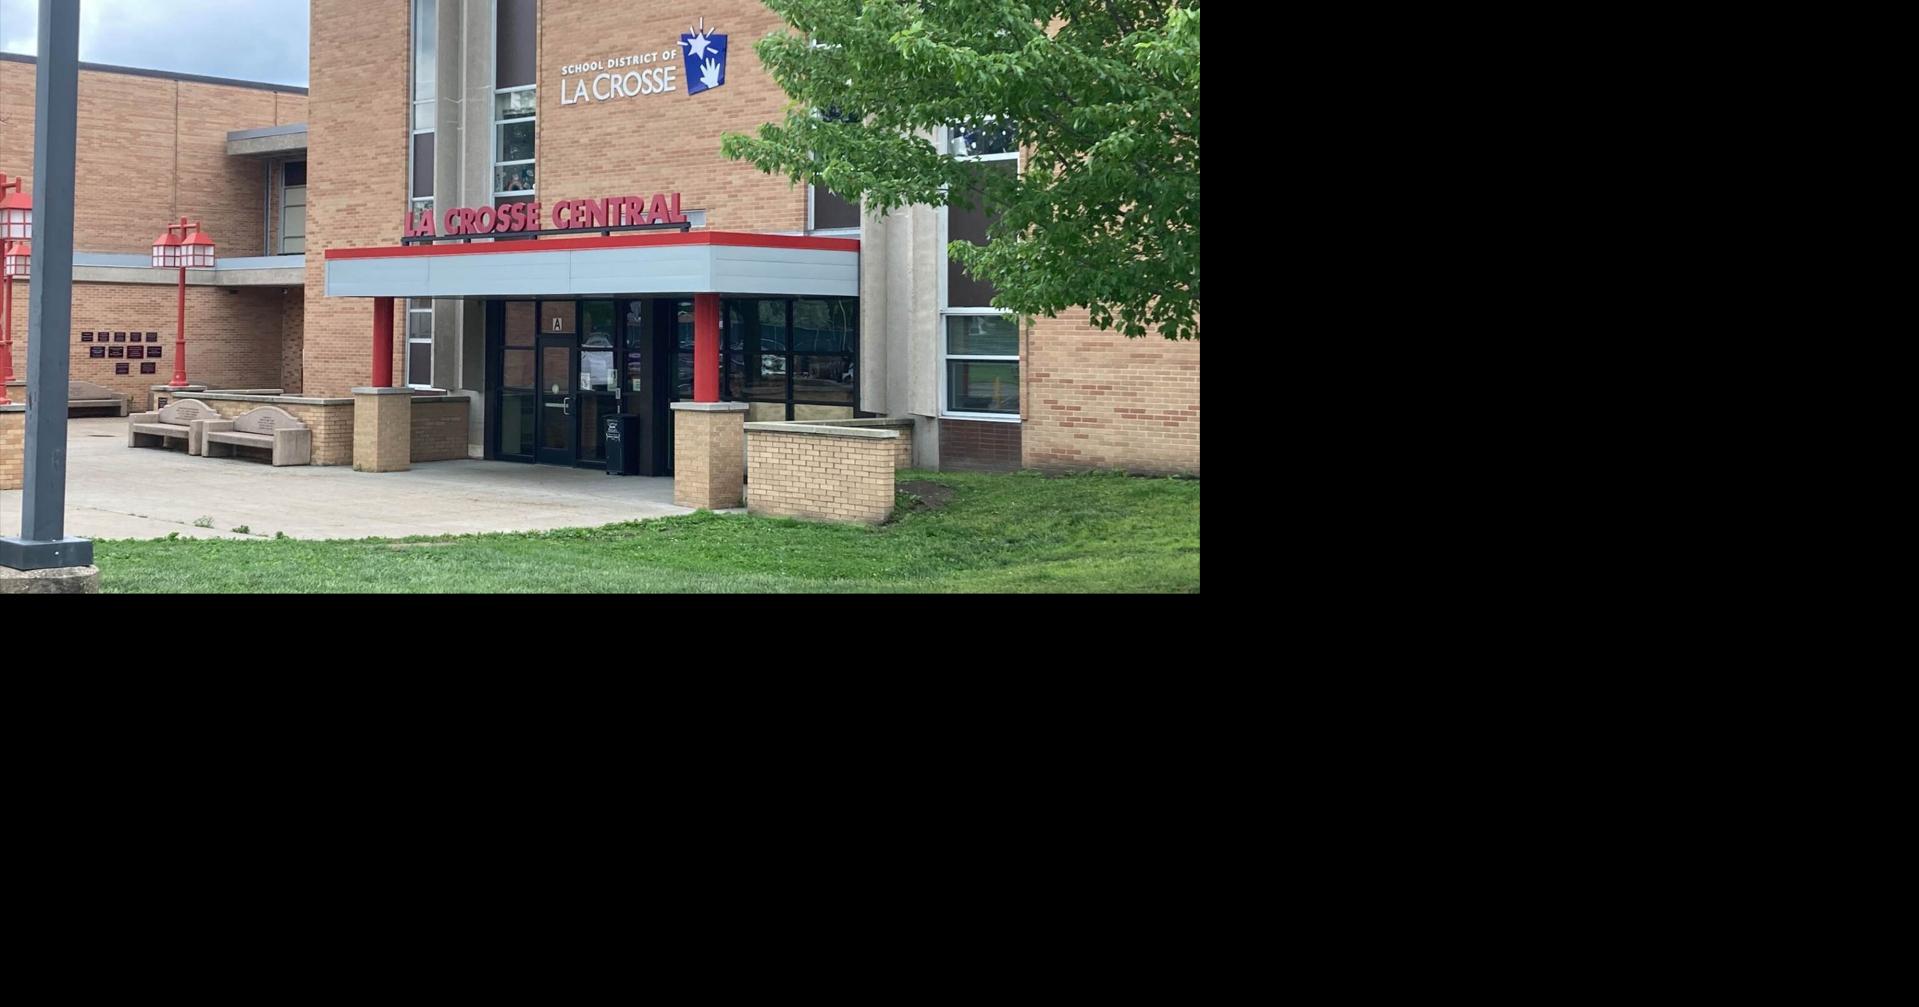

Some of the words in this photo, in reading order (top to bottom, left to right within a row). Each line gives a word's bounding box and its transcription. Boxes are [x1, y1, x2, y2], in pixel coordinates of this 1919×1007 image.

[561, 61, 604, 75] SCHOOL
[607, 52, 658, 68] DISTRICT
[662, 49, 677, 61] OF
[561, 78, 590, 105] LA
[592, 65, 677, 101] CROSSE
[404, 208, 436, 237] LA
[444, 202, 542, 235] CROSSE
[552, 192, 687, 229] CENTRAL
[554, 317, 561, 330] A
